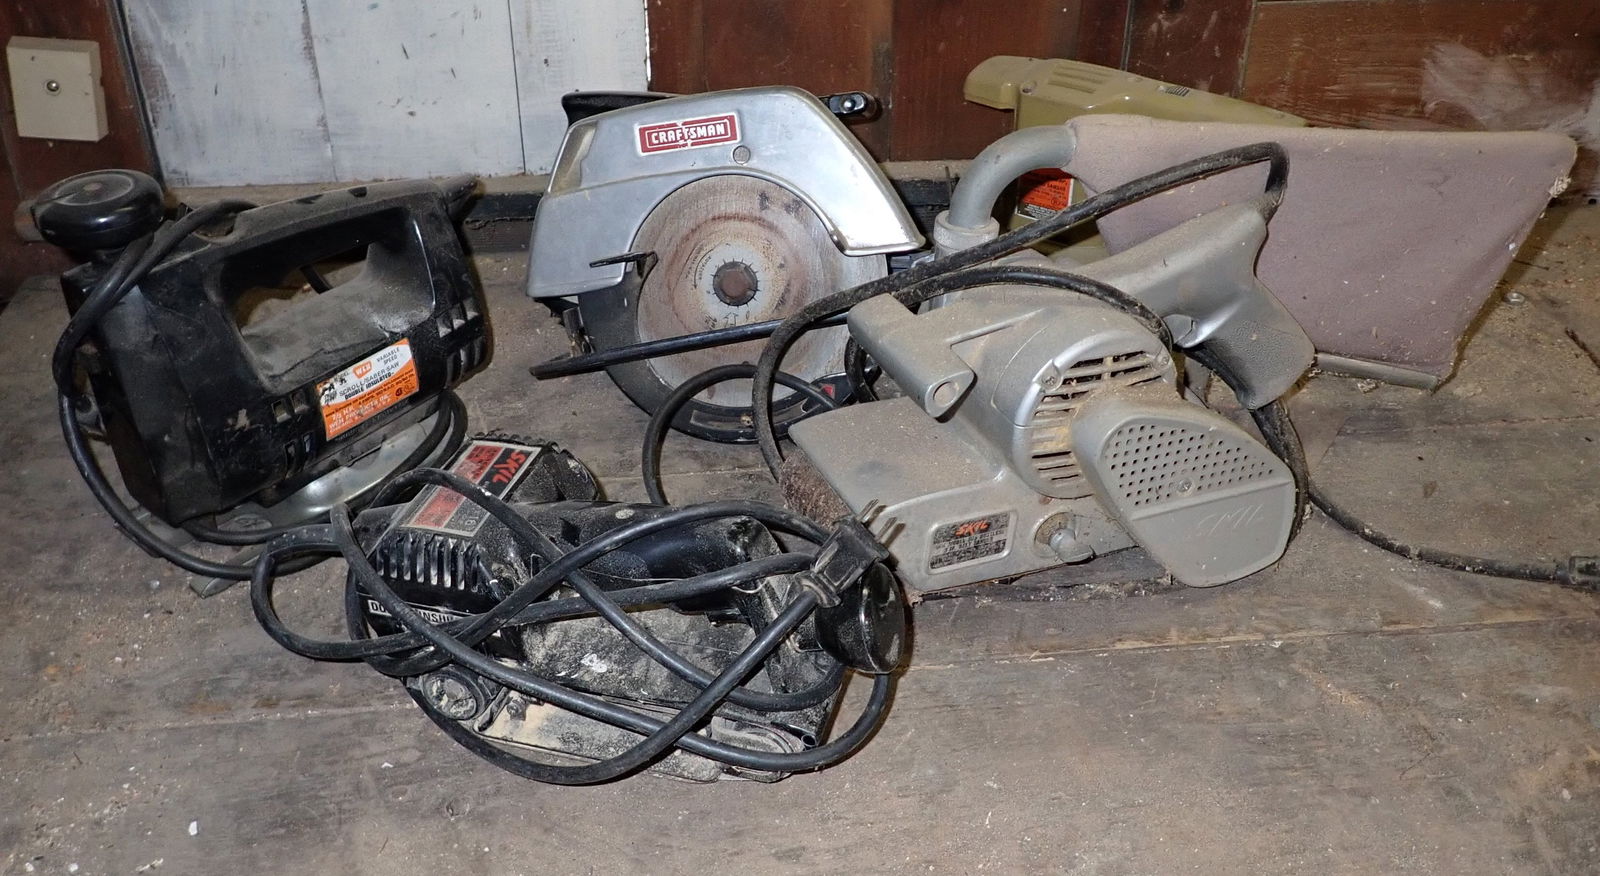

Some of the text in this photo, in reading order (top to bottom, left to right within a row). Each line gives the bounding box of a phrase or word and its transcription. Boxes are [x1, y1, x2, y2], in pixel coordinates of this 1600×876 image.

[651, 124, 725, 144] CRAFTSMAN
[376, 347, 400, 362] VARIABLE
[383, 355, 398, 365] SPEED
[387, 361, 400, 373] SAW
[345, 386, 364, 401] DOUBLE
[366, 372, 392, 389] INSULATED
[492, 452, 526, 483] SKIL
[955, 520, 988, 536] SKIL
